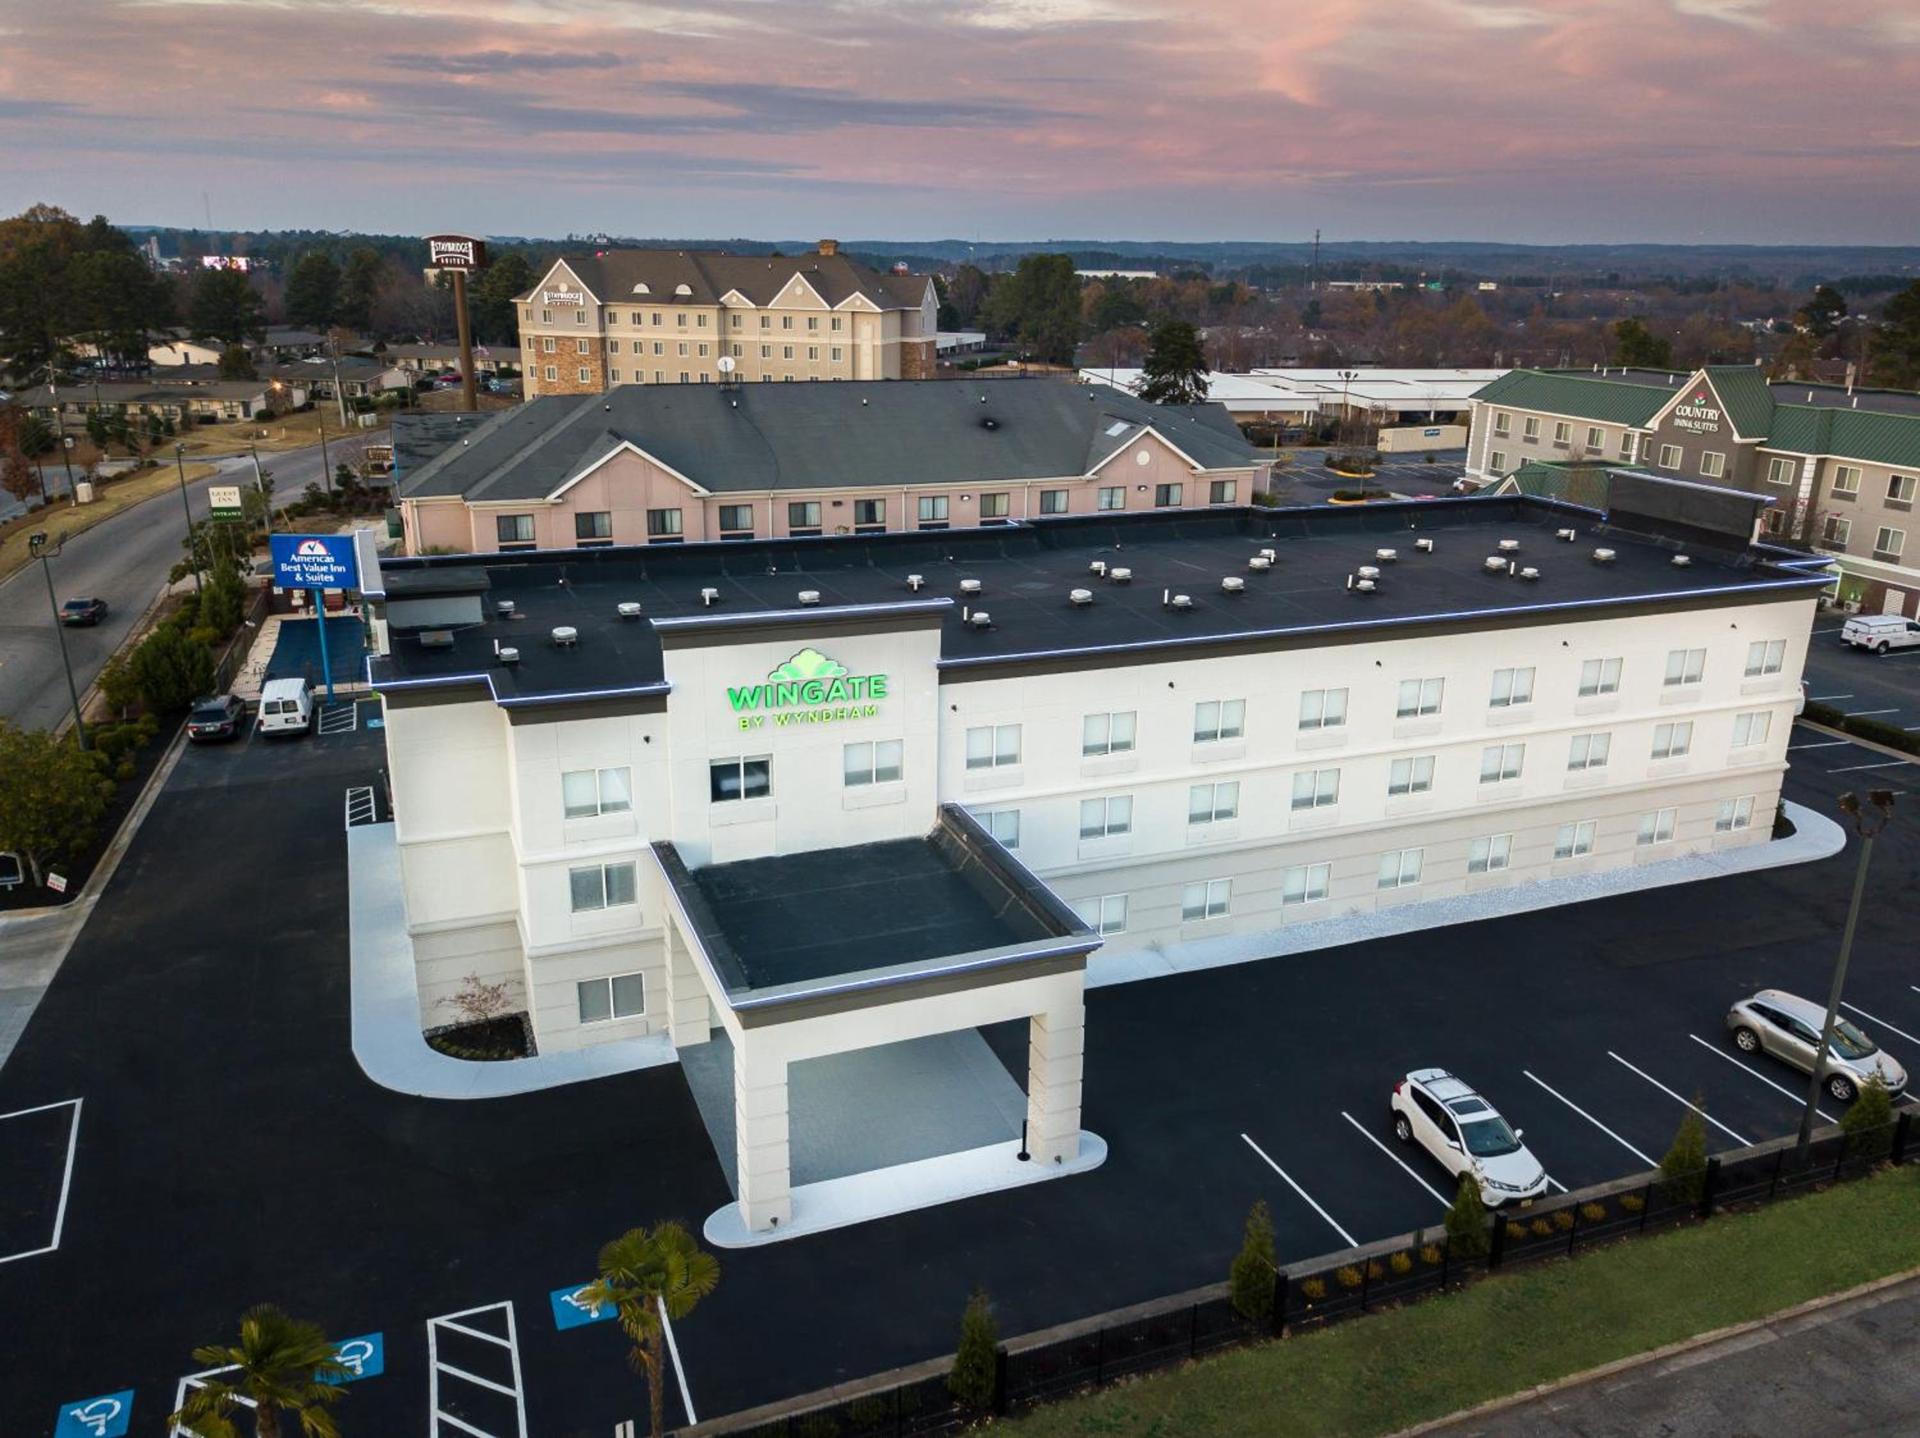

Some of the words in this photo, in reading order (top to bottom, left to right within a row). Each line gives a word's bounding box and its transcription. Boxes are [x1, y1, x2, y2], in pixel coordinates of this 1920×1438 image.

[434, 241, 469, 253] STAYBRIDGE
[1675, 405, 1720, 420] COUNTRY
[1693, 421, 1719, 432] SUITES
[290, 553, 335, 563] Americas
[281, 562, 301, 572] Best
[302, 563, 328, 573] Value
[330, 564, 346, 573] Inn
[295, 573, 303, 582] &
[305, 572, 335, 583] Suites
[726, 674, 888, 712] WINGATE
[738, 715, 764, 732] BY
[774, 704, 878, 727] WYNDHAM
